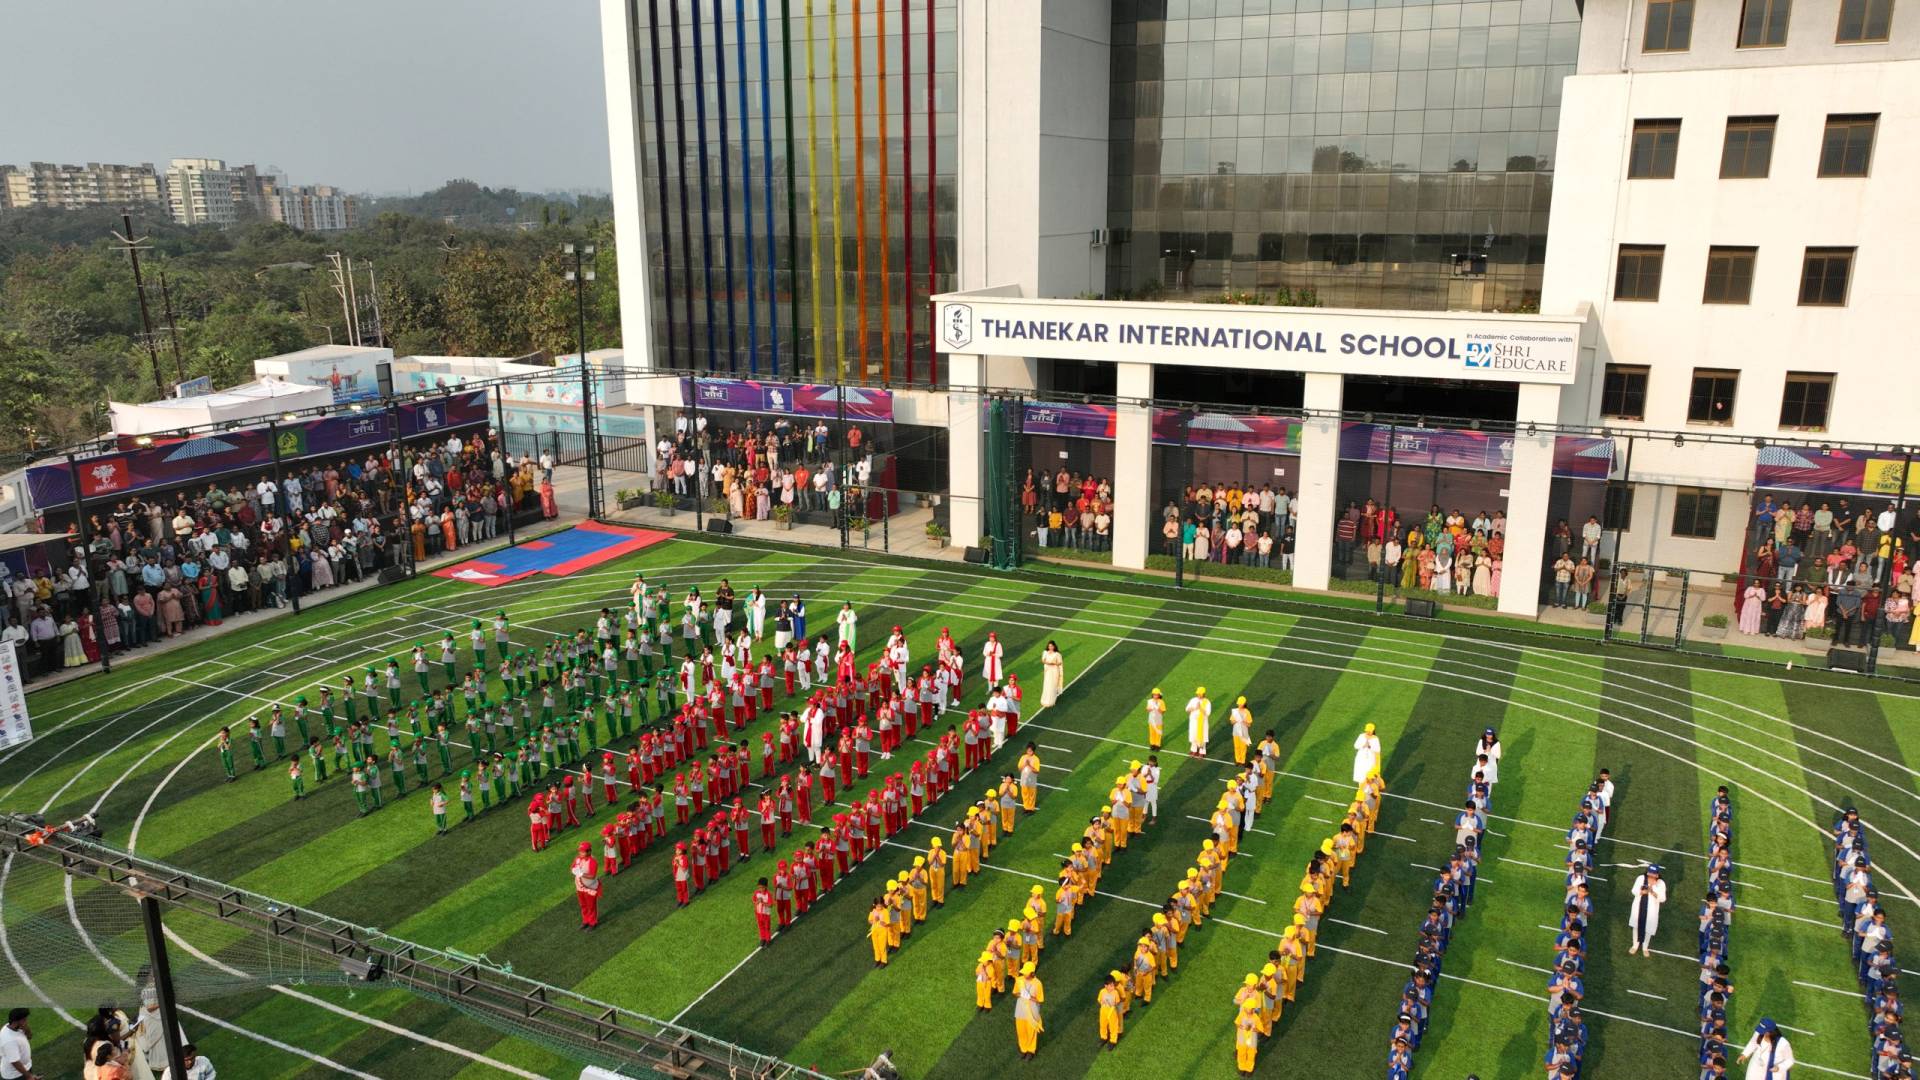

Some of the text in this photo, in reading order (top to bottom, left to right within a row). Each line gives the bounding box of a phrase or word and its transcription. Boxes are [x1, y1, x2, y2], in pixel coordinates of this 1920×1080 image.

[981, 318, 1461, 360] THANEKAR INTERNATIONAL SCHOOL
[1474, 333, 1508, 341] Academic
[1509, 334, 1557, 343] Collaboration
[1494, 342, 1531, 358] SHRI
[1494, 356, 1567, 372] EDUCARE
